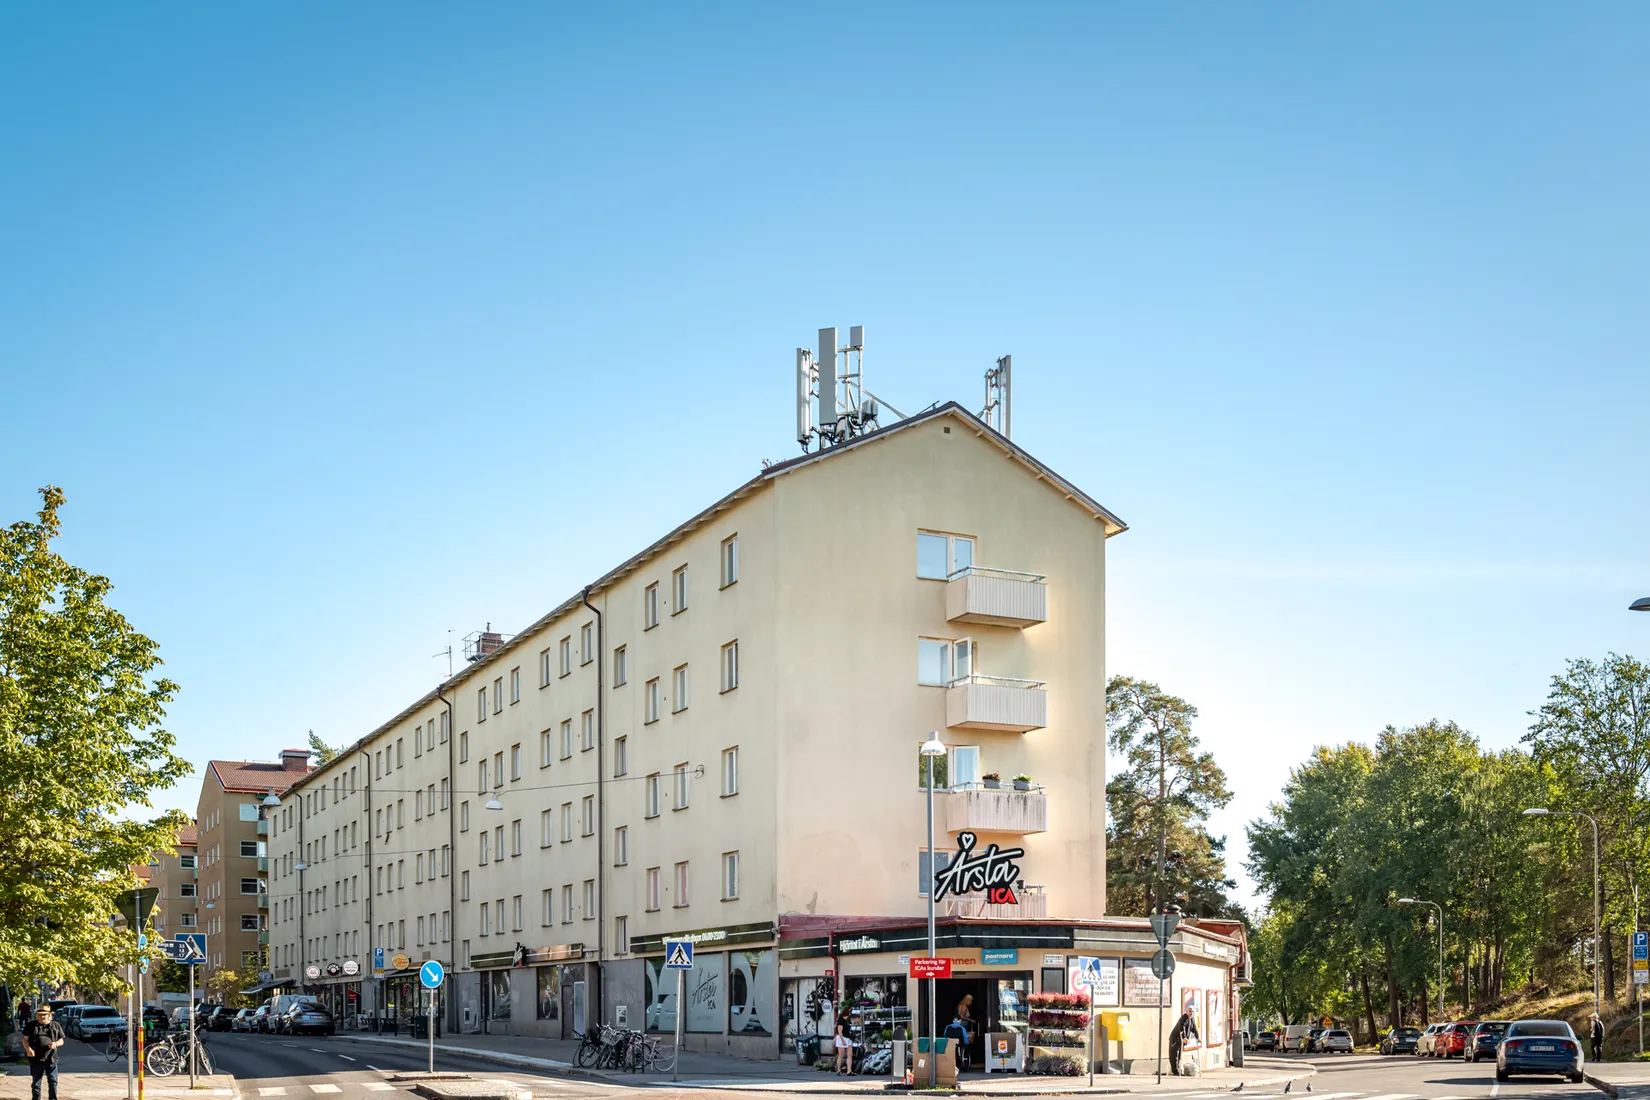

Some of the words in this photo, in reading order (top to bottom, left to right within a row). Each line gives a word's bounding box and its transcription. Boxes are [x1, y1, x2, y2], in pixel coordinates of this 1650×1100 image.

[935, 834, 1021, 900] Årsta
[990, 888, 1017, 904] ICA
[1637, 934, 1645, 945] P
